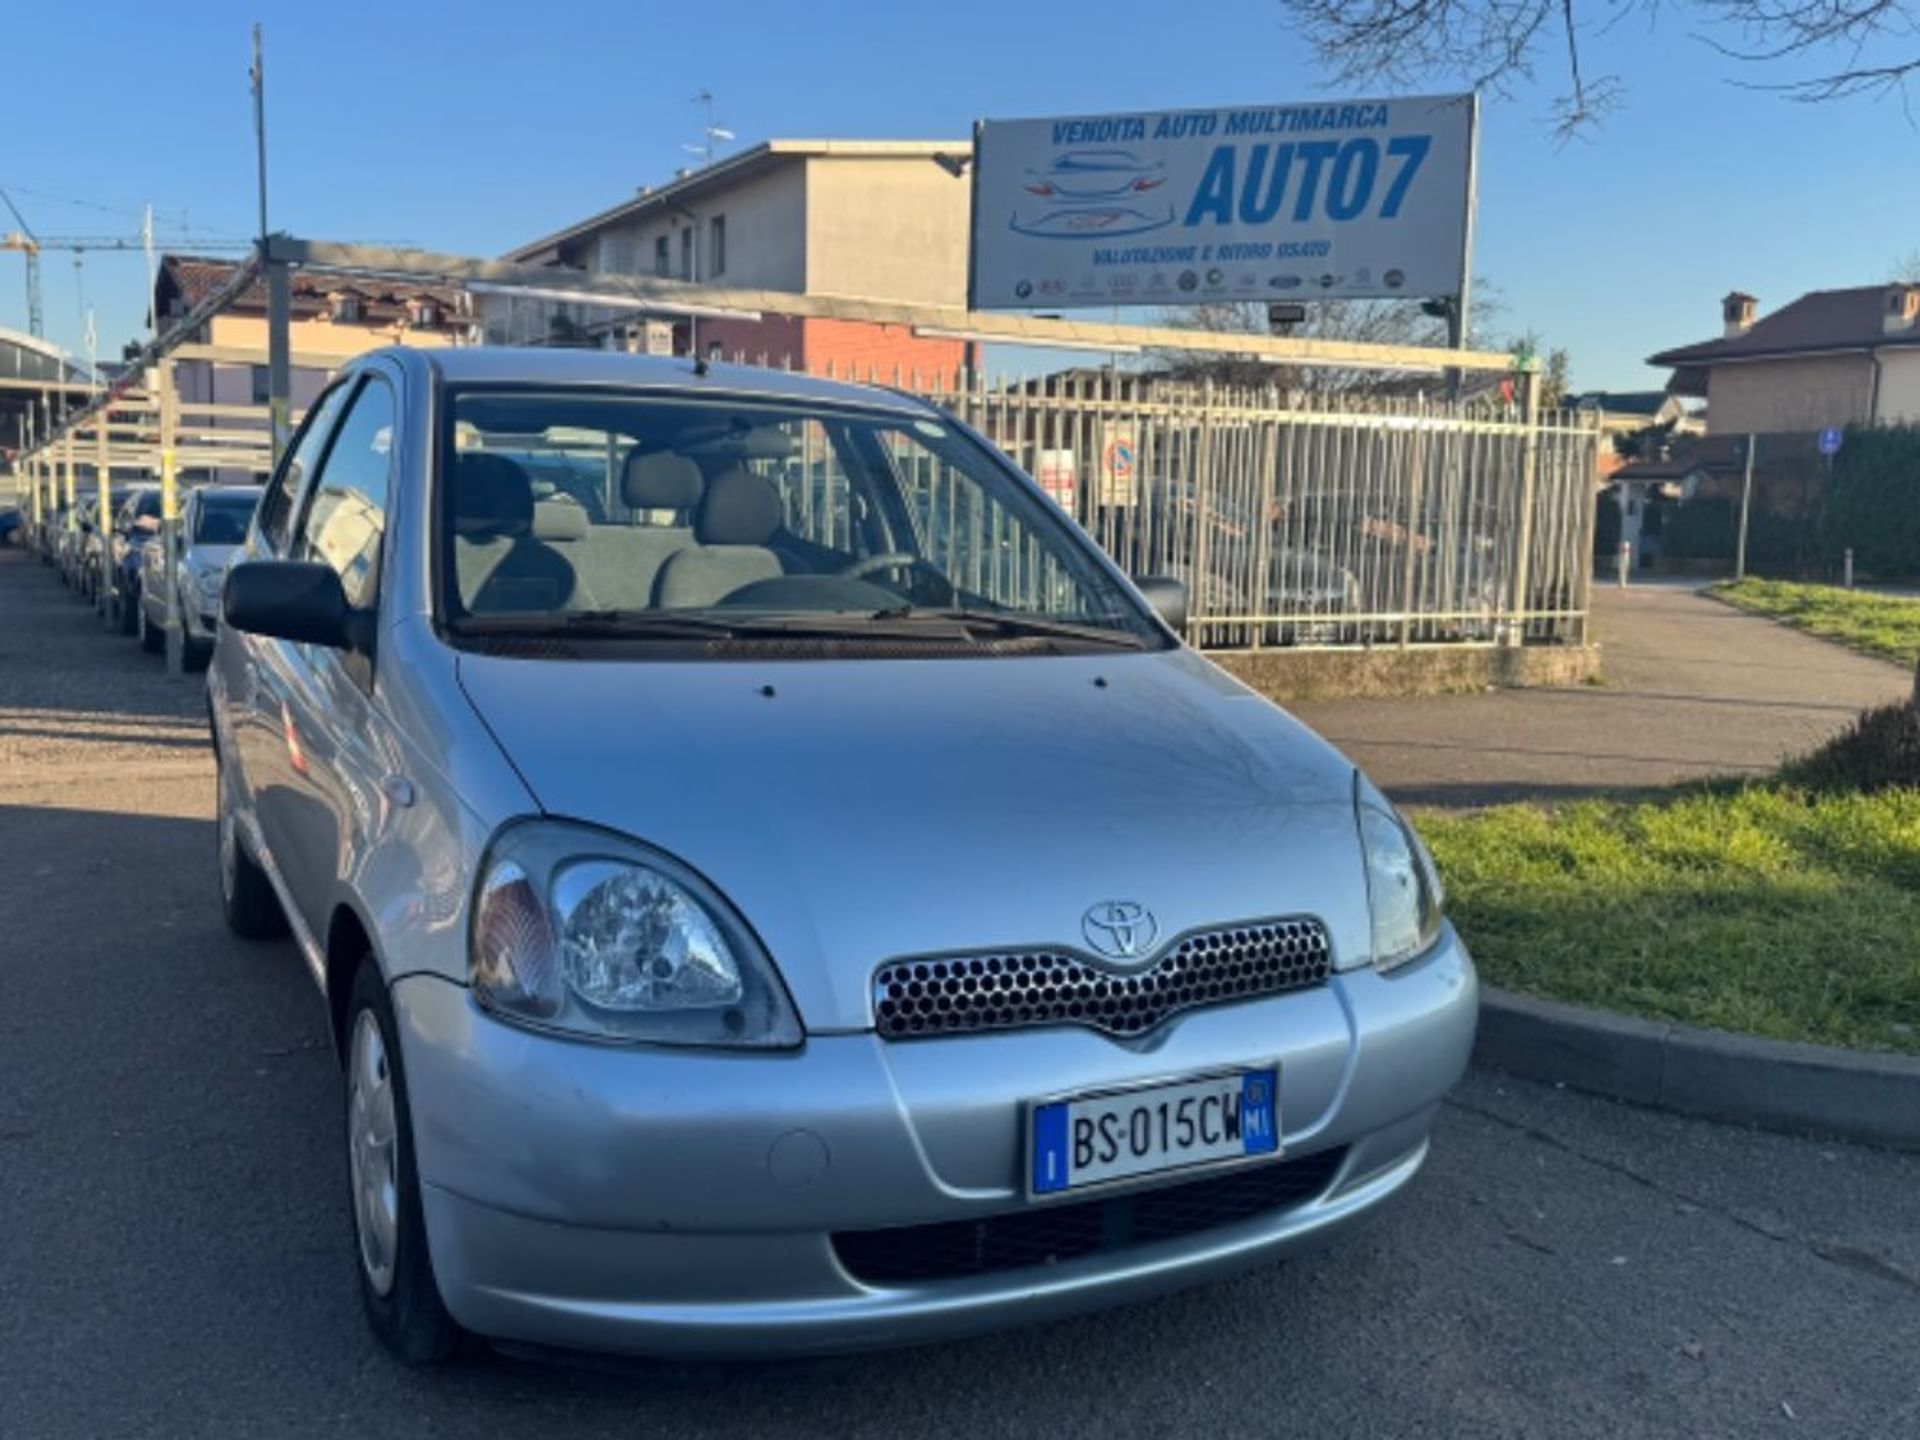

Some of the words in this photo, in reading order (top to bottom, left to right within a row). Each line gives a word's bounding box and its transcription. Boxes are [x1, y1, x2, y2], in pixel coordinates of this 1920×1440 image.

[1052, 117, 1145, 144] VENDITA
[1153, 113, 1218, 139] AUTO
[1224, 104, 1389, 135] MULTIMARCA
[1182, 134, 1432, 228] AUTO7
[1244, 1106, 1270, 1137] MI
